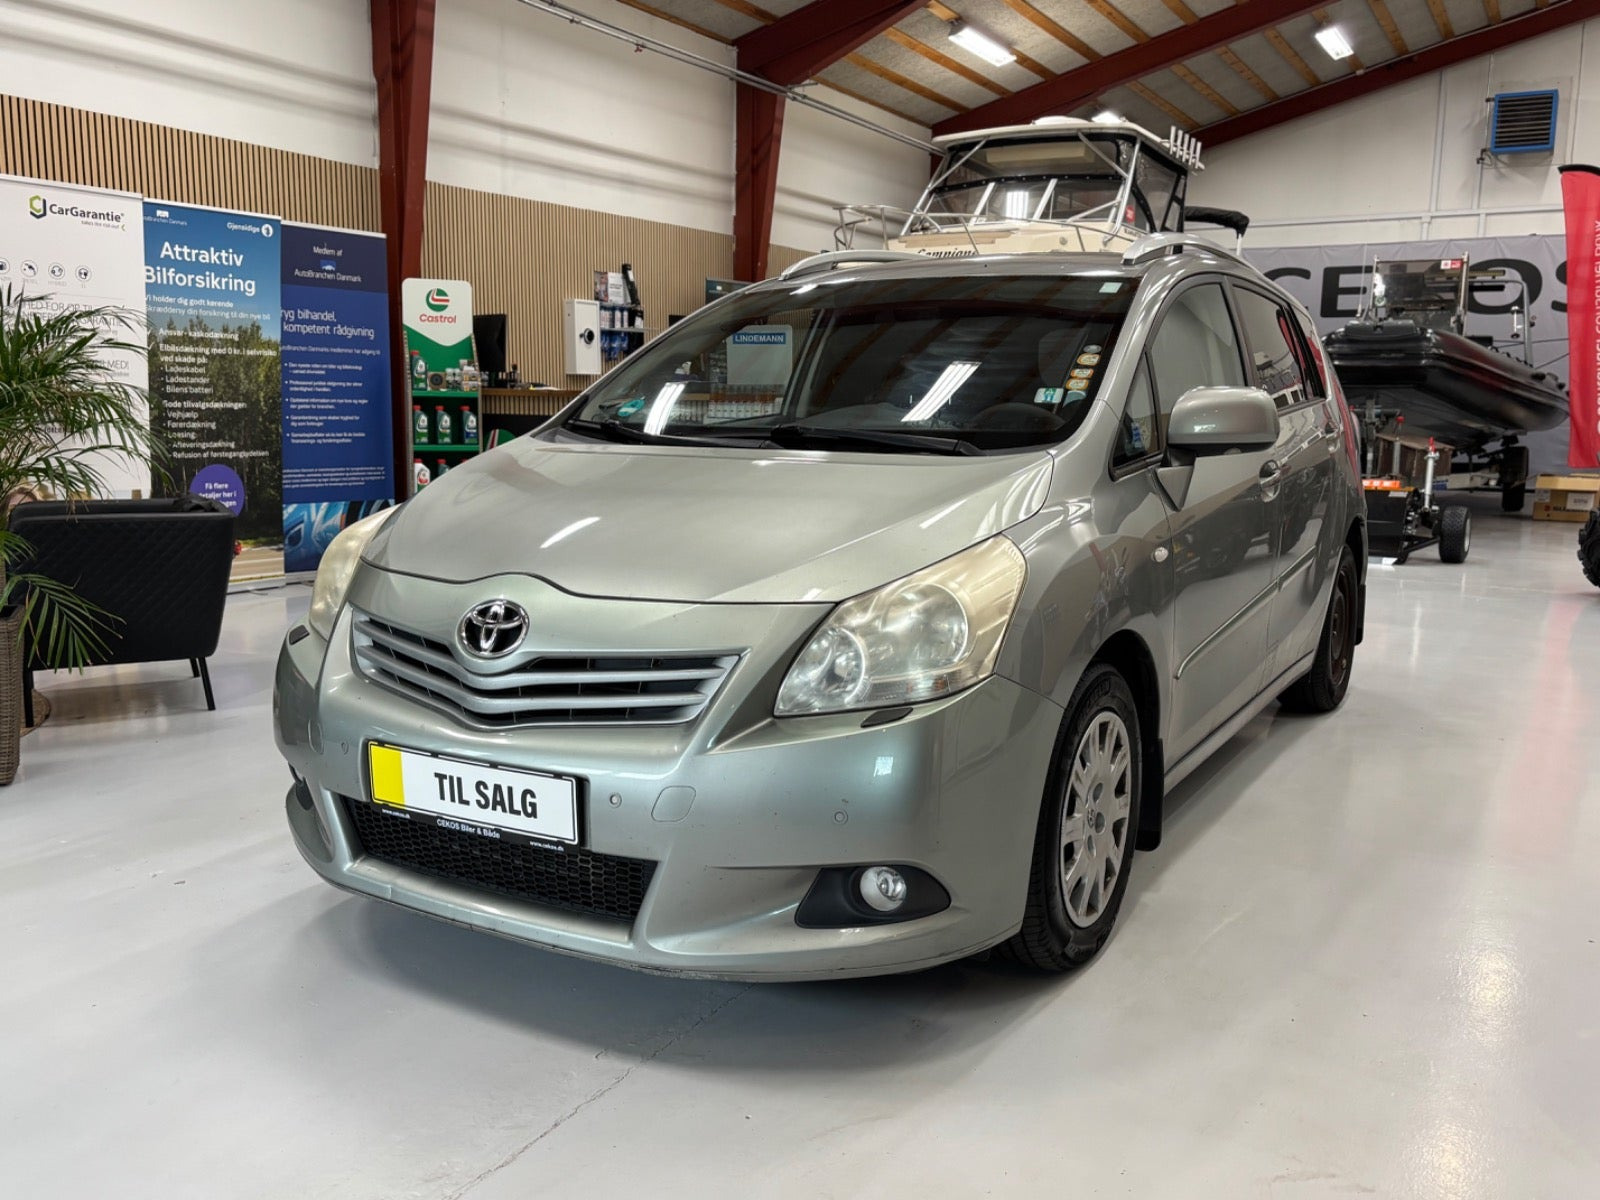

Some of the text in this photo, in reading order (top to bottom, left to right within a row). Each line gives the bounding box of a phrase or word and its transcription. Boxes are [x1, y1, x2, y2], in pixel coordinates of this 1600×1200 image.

[49, 203, 121, 222] CarGarantie
[227, 222, 260, 233] Gjensidige
[160, 241, 243, 267] Attraktiv
[313, 246, 335, 256] Medlem
[144, 265, 256, 297] Bilforsikring
[294, 268, 362, 282] AutoBranchen Danmark
[153, 295, 176, 304] holder
[177, 297, 188, 306] dig
[189, 298, 206, 307] godt
[280, 308, 337, 322] ryg bilhandel,
[419, 313, 457, 324] Castrol
[283, 322, 375, 340] kompetent rådgivning
[734, 333, 784, 343] LINDEMANN
[205, 482, 213, 490] Få
[434, 772, 538, 819] TIL SALG
